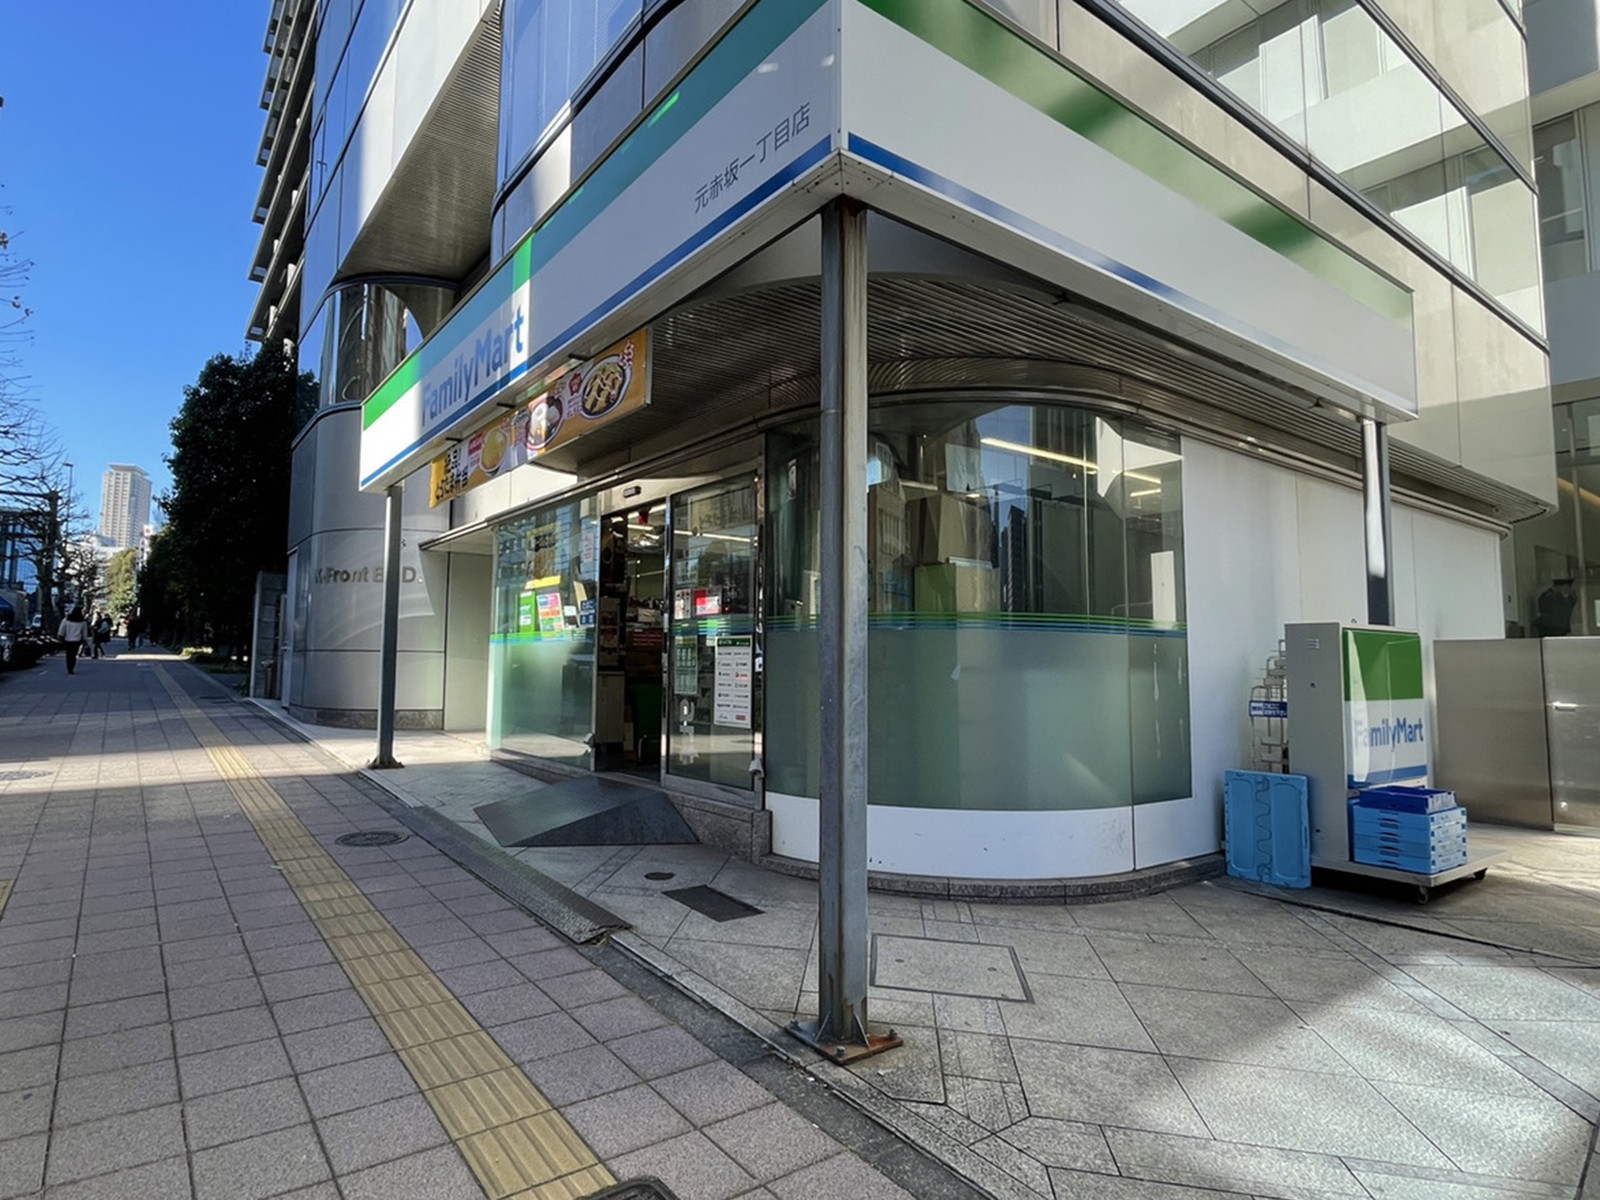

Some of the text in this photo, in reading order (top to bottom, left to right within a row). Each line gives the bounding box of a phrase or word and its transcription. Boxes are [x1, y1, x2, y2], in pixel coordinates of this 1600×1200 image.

[694, 102, 810, 214] 元赤坂一丁目店
[421, 304, 523, 427] FamilyMart
[1354, 717, 1424, 752] FamilyMart
